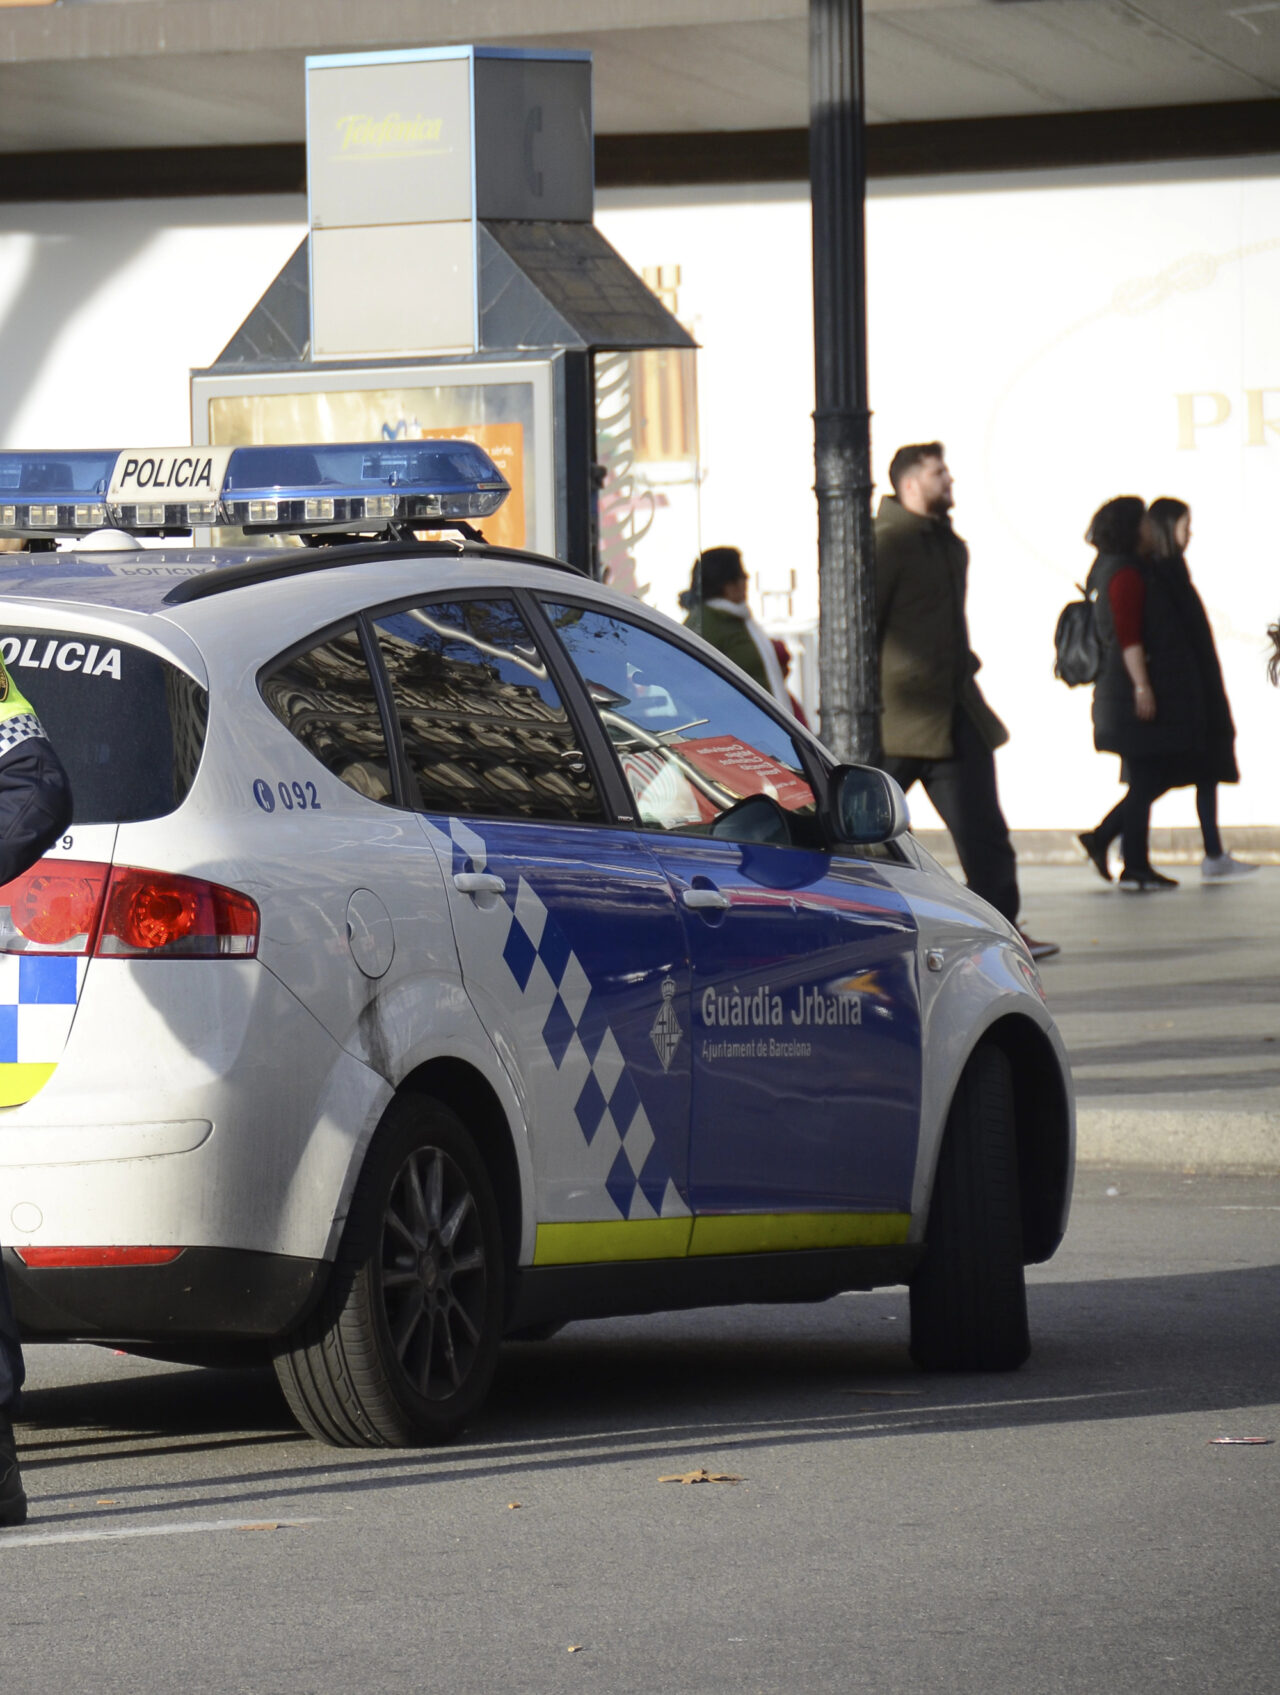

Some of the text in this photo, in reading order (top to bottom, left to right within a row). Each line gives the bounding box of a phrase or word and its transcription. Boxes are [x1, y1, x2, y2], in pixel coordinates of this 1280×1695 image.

[120, 458, 212, 488] POLICIA
[277, 780, 322, 810] 092
[702, 985, 783, 1027] Guàrdia
[702, 1038, 812, 1062] Ajuntament de Barcelona
